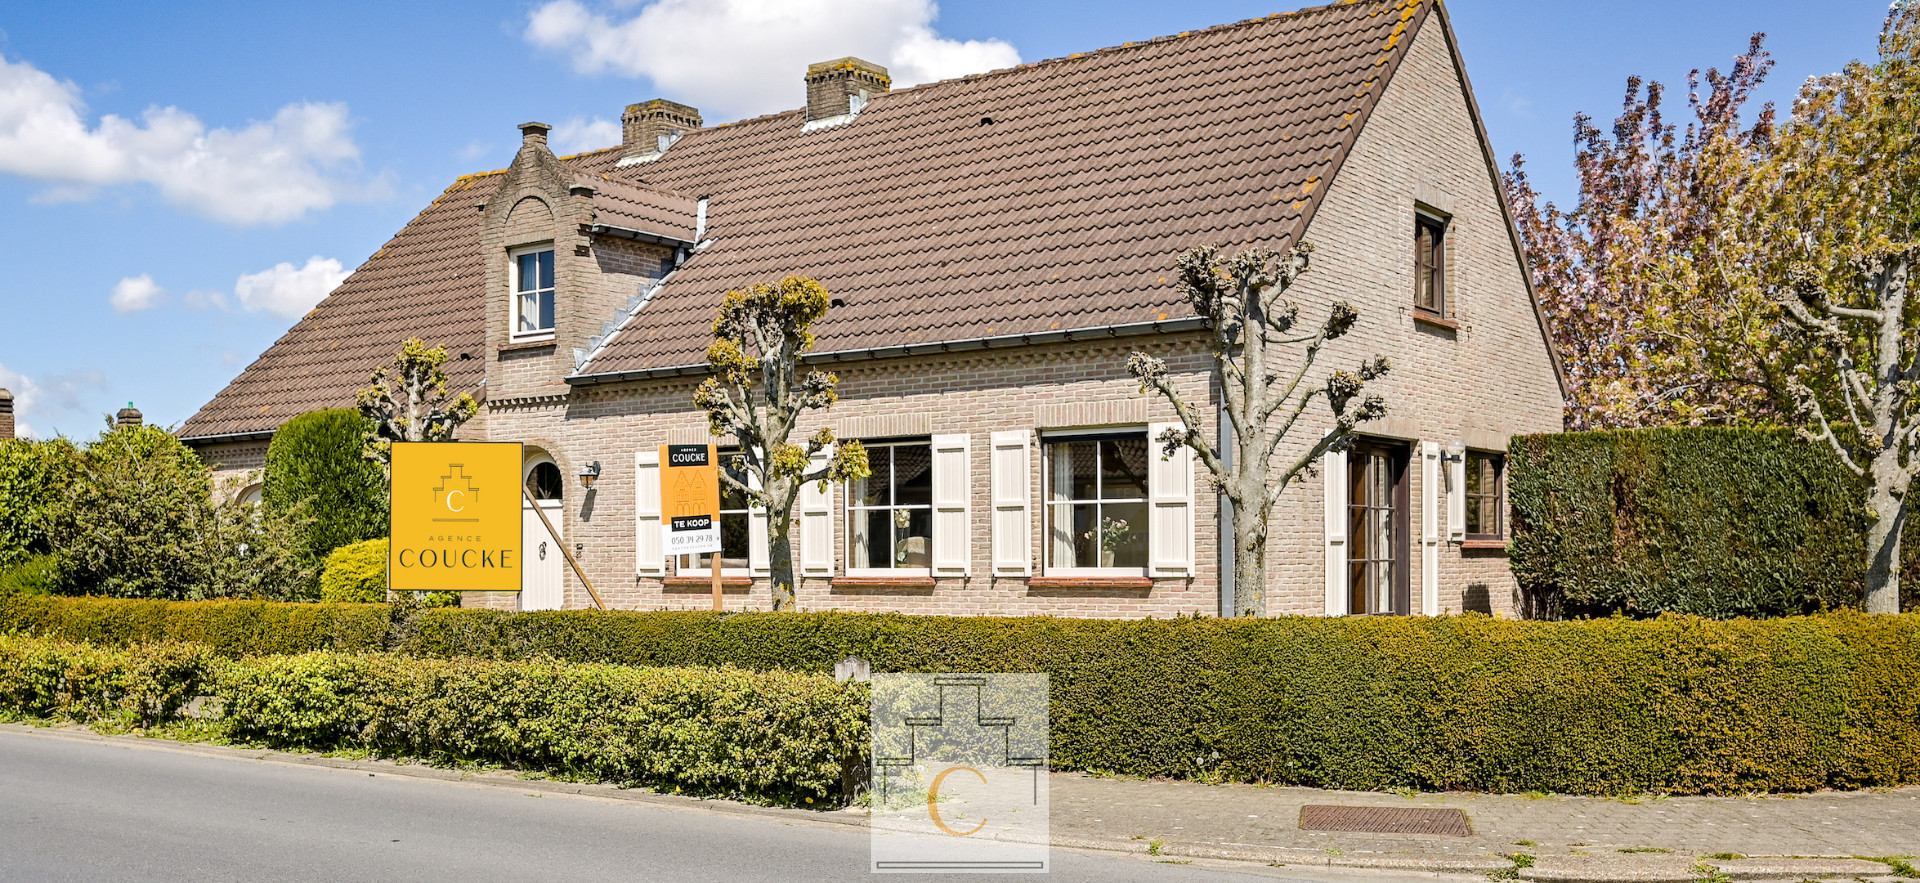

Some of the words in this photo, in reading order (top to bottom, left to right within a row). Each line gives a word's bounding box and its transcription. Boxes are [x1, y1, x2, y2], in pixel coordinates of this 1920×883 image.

[672, 453, 706, 463] COUCKE
[447, 490, 465, 512] C
[674, 520, 686, 528] TE
[686, 519, 710, 528] KOOP
[671, 537, 685, 545] 050
[705, 534, 713, 542] 78
[399, 548, 513, 568] COUCKE
